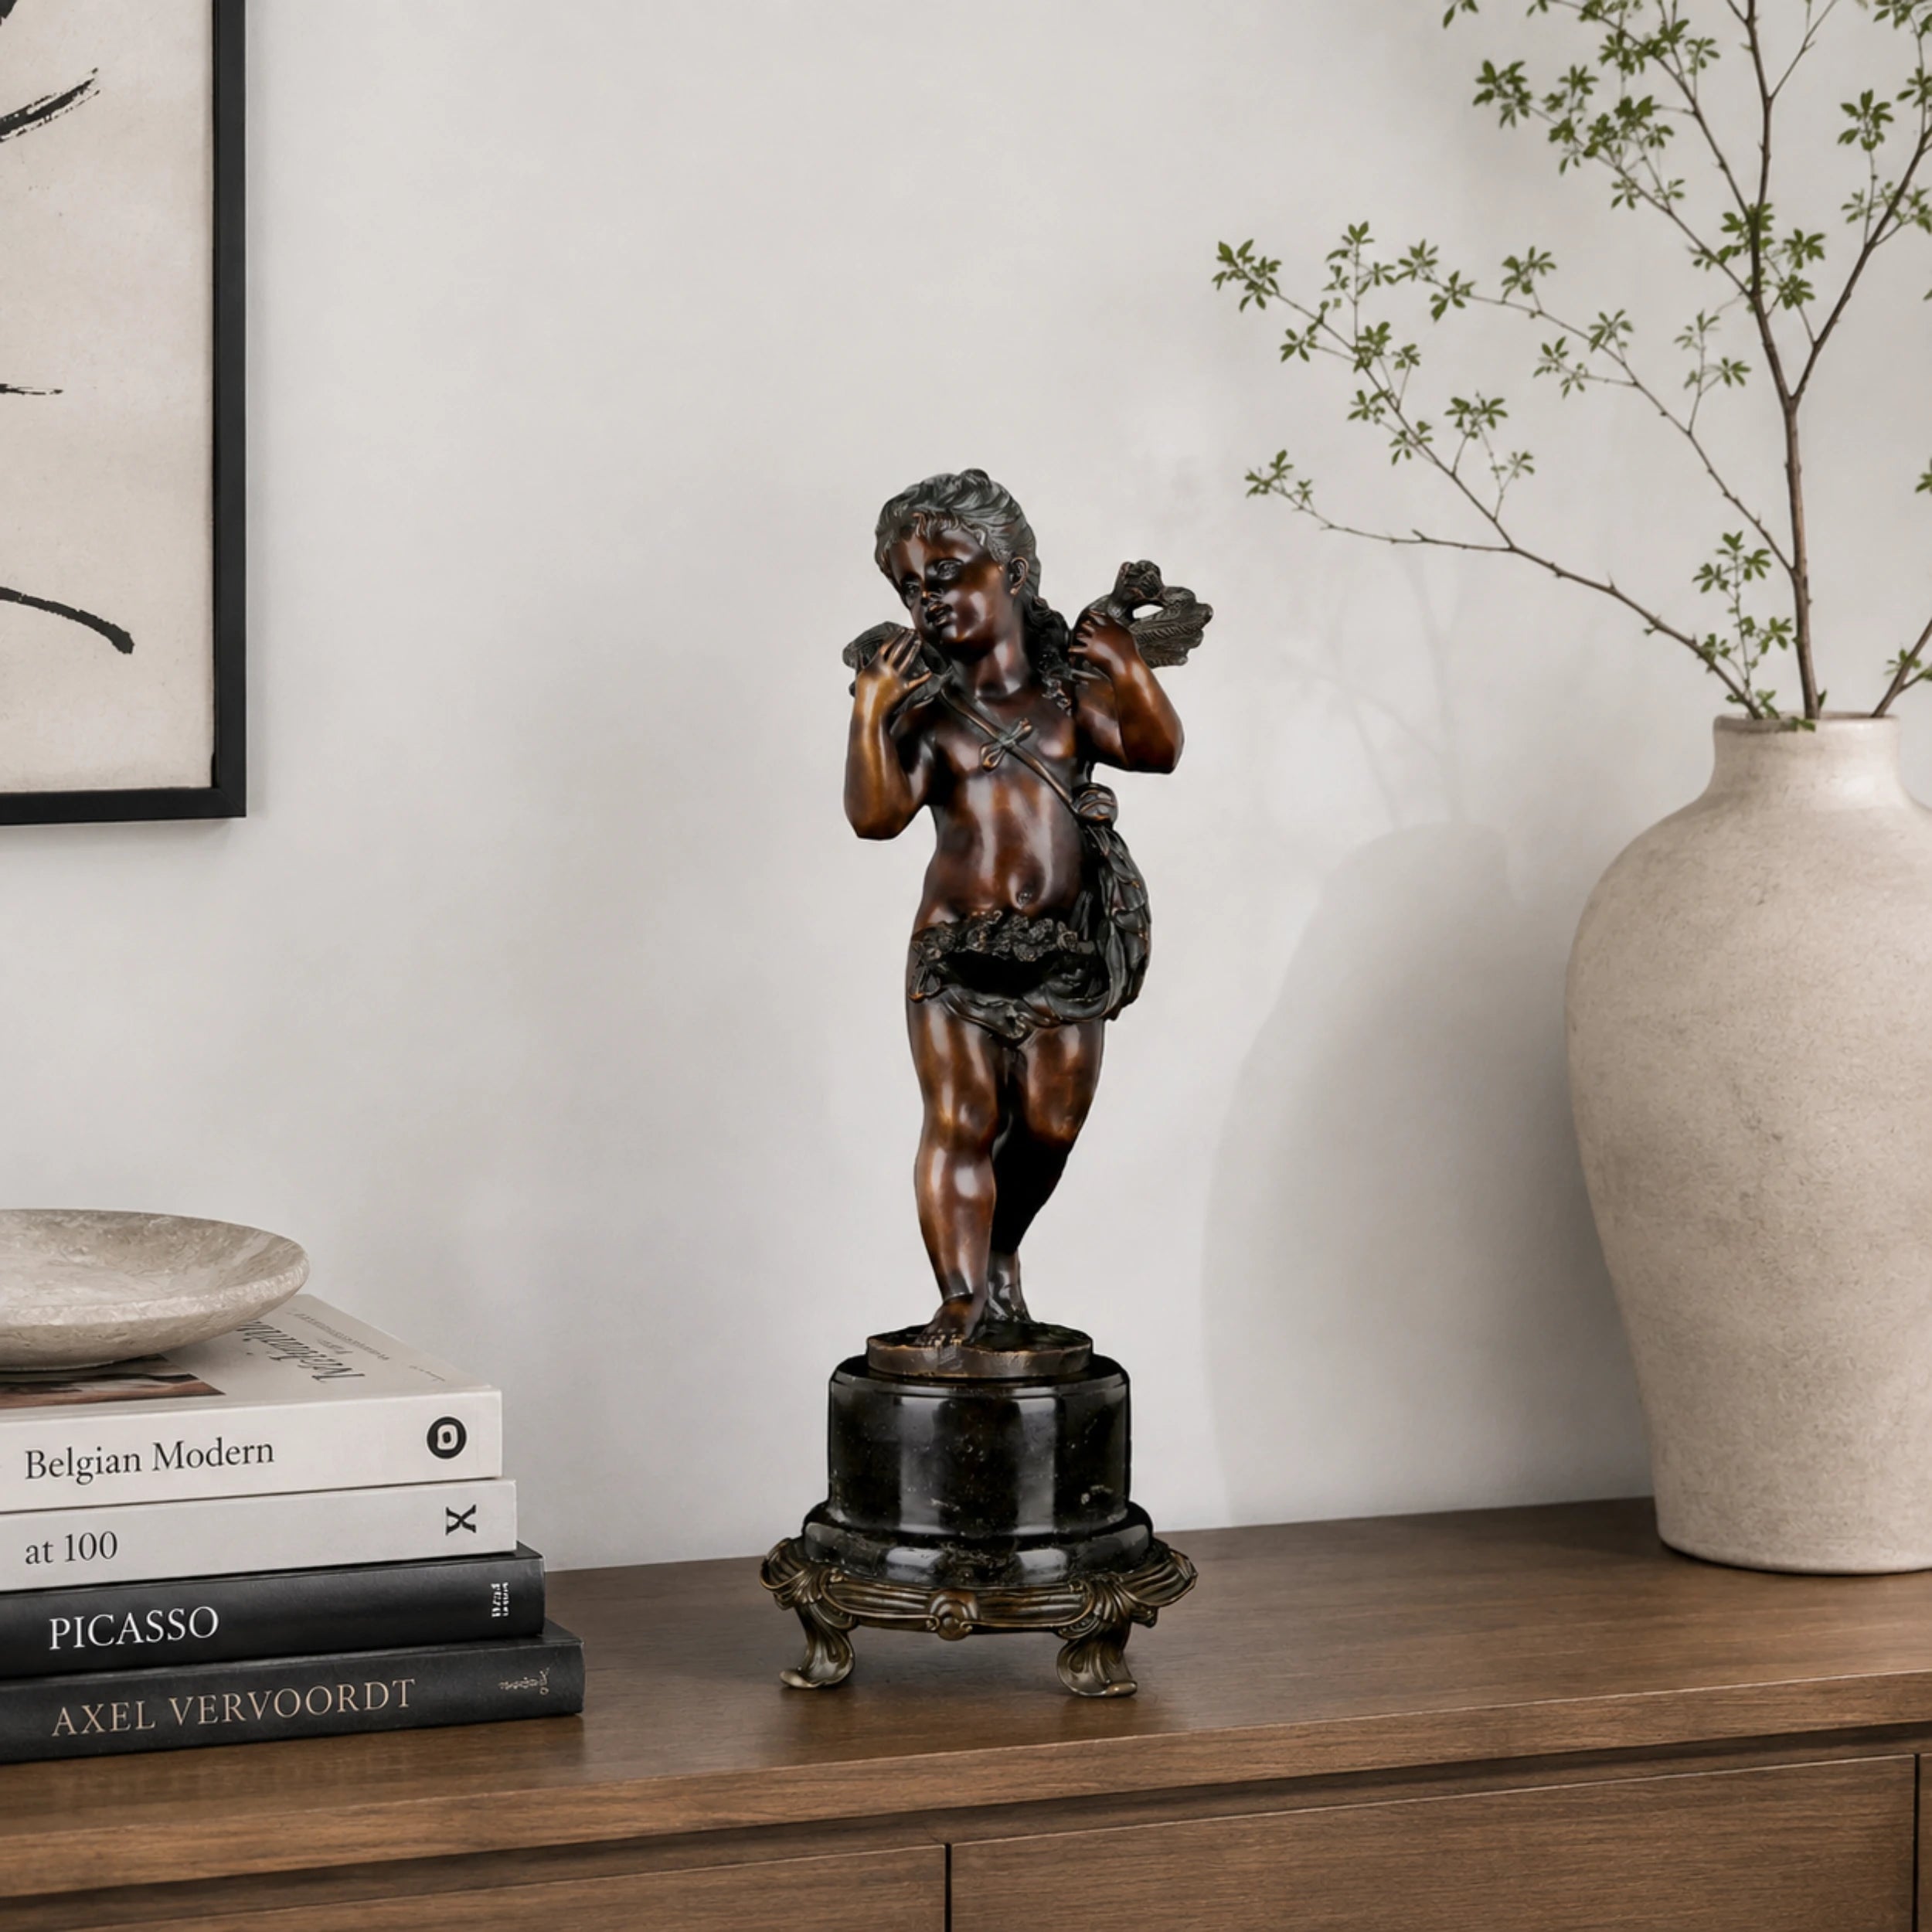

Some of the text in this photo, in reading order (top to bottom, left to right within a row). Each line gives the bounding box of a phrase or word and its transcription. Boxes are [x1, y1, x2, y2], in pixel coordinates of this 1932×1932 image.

[25, 1436, 274, 1486] Belgian Modern
[25, 1531, 118, 1565] at 100
[49, 1605, 219, 1650] PICASSO
[52, 1679, 415, 1736] AXEL VERVOORDT
